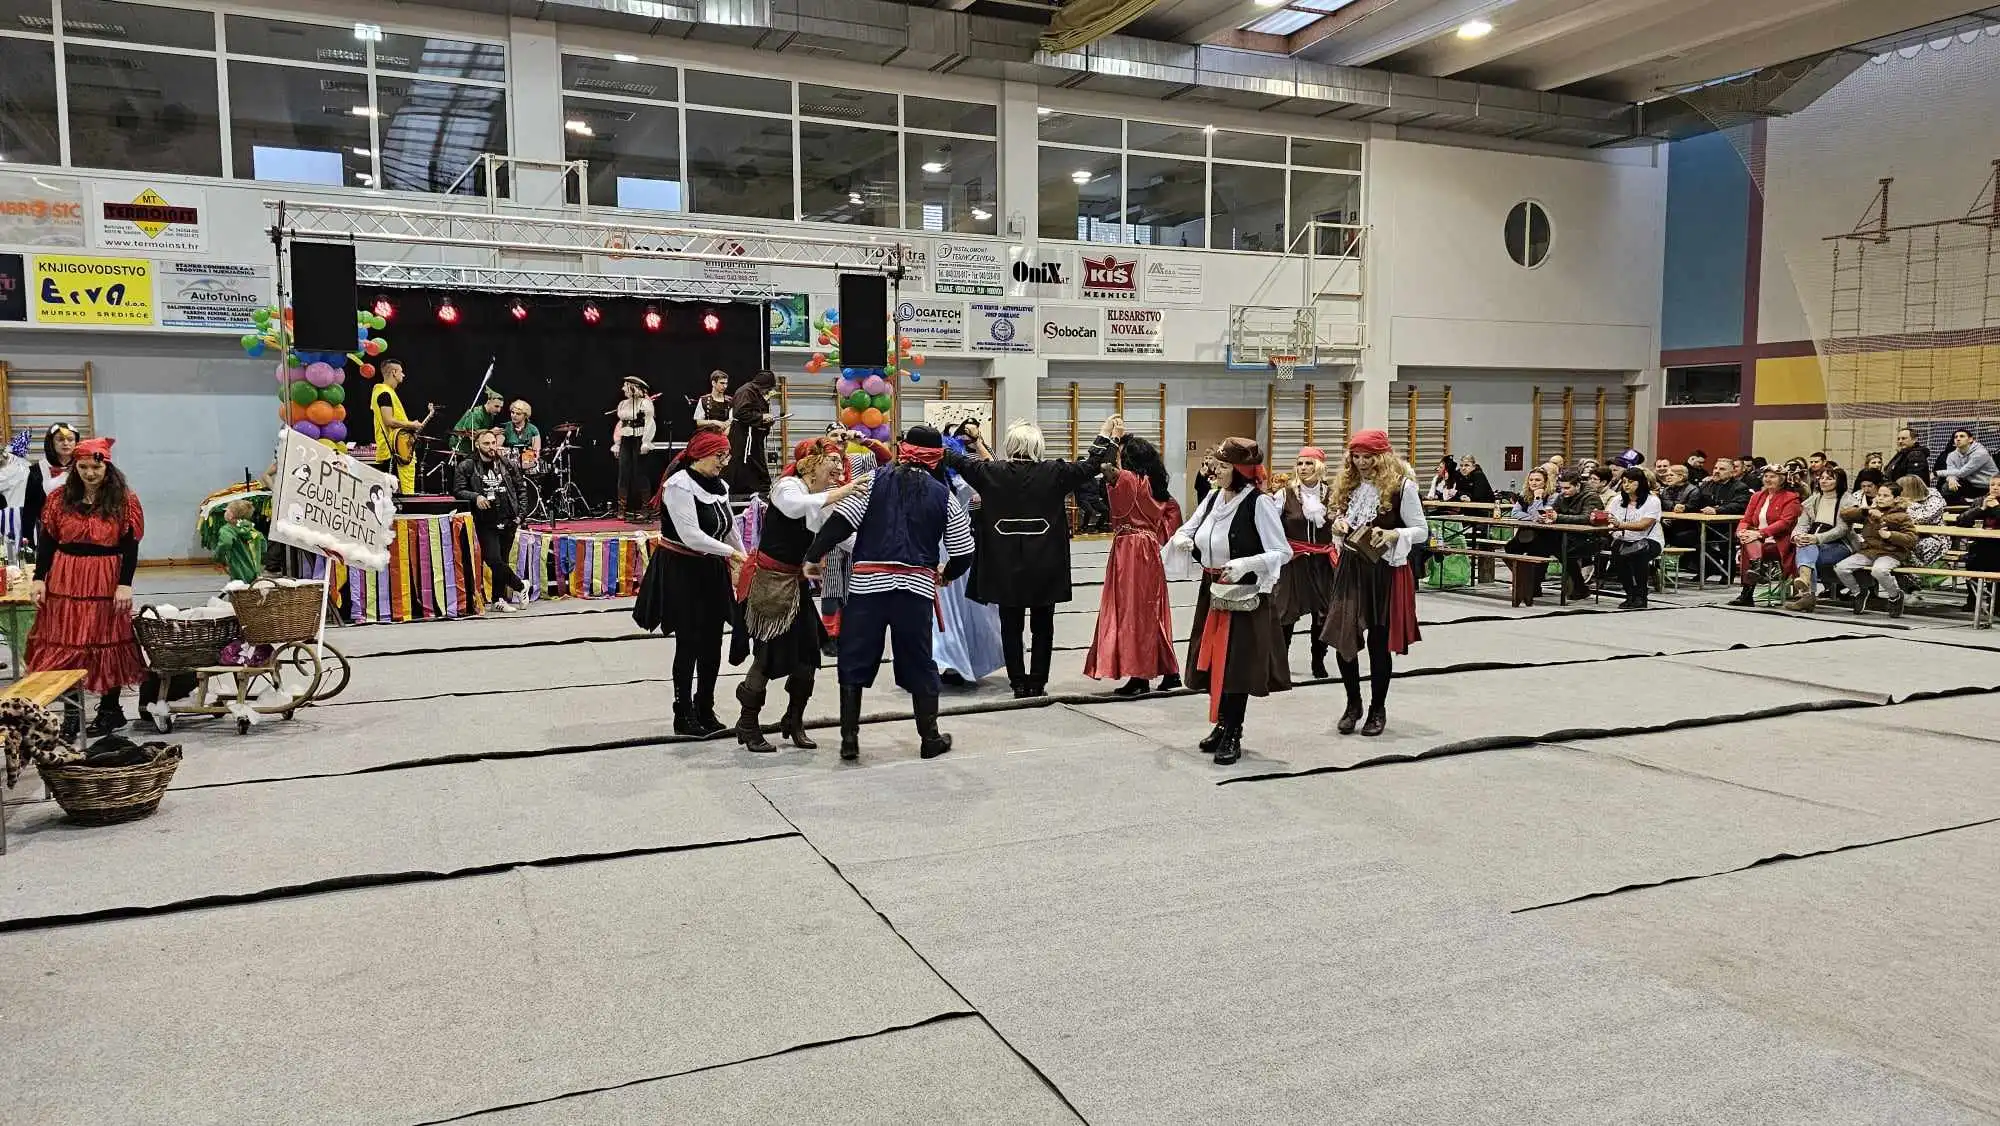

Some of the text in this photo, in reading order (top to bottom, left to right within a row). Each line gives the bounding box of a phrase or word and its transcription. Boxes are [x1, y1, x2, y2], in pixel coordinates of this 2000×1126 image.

[142, 195, 157, 204] MT
[104, 239, 200, 251] www.termoinst.hr
[38, 262, 146, 277] KNJIGOVODSTVO
[1012, 260, 1062, 285] OniX
[1090, 266, 1129, 284] KIŠ
[1084, 291, 1136, 299] MESNICE
[41, 309, 87, 317] MURSKO
[1107, 309, 1161, 322] KLESARSTVO
[1043, 321, 1097, 339] Sobočan
[1111, 324, 1145, 335] NOVAK
[1510, 453, 1518, 463] H
[319, 460, 363, 500] PTT
[296, 477, 368, 522] ZGUBLENI
[304, 502, 376, 546] PINGVINI
